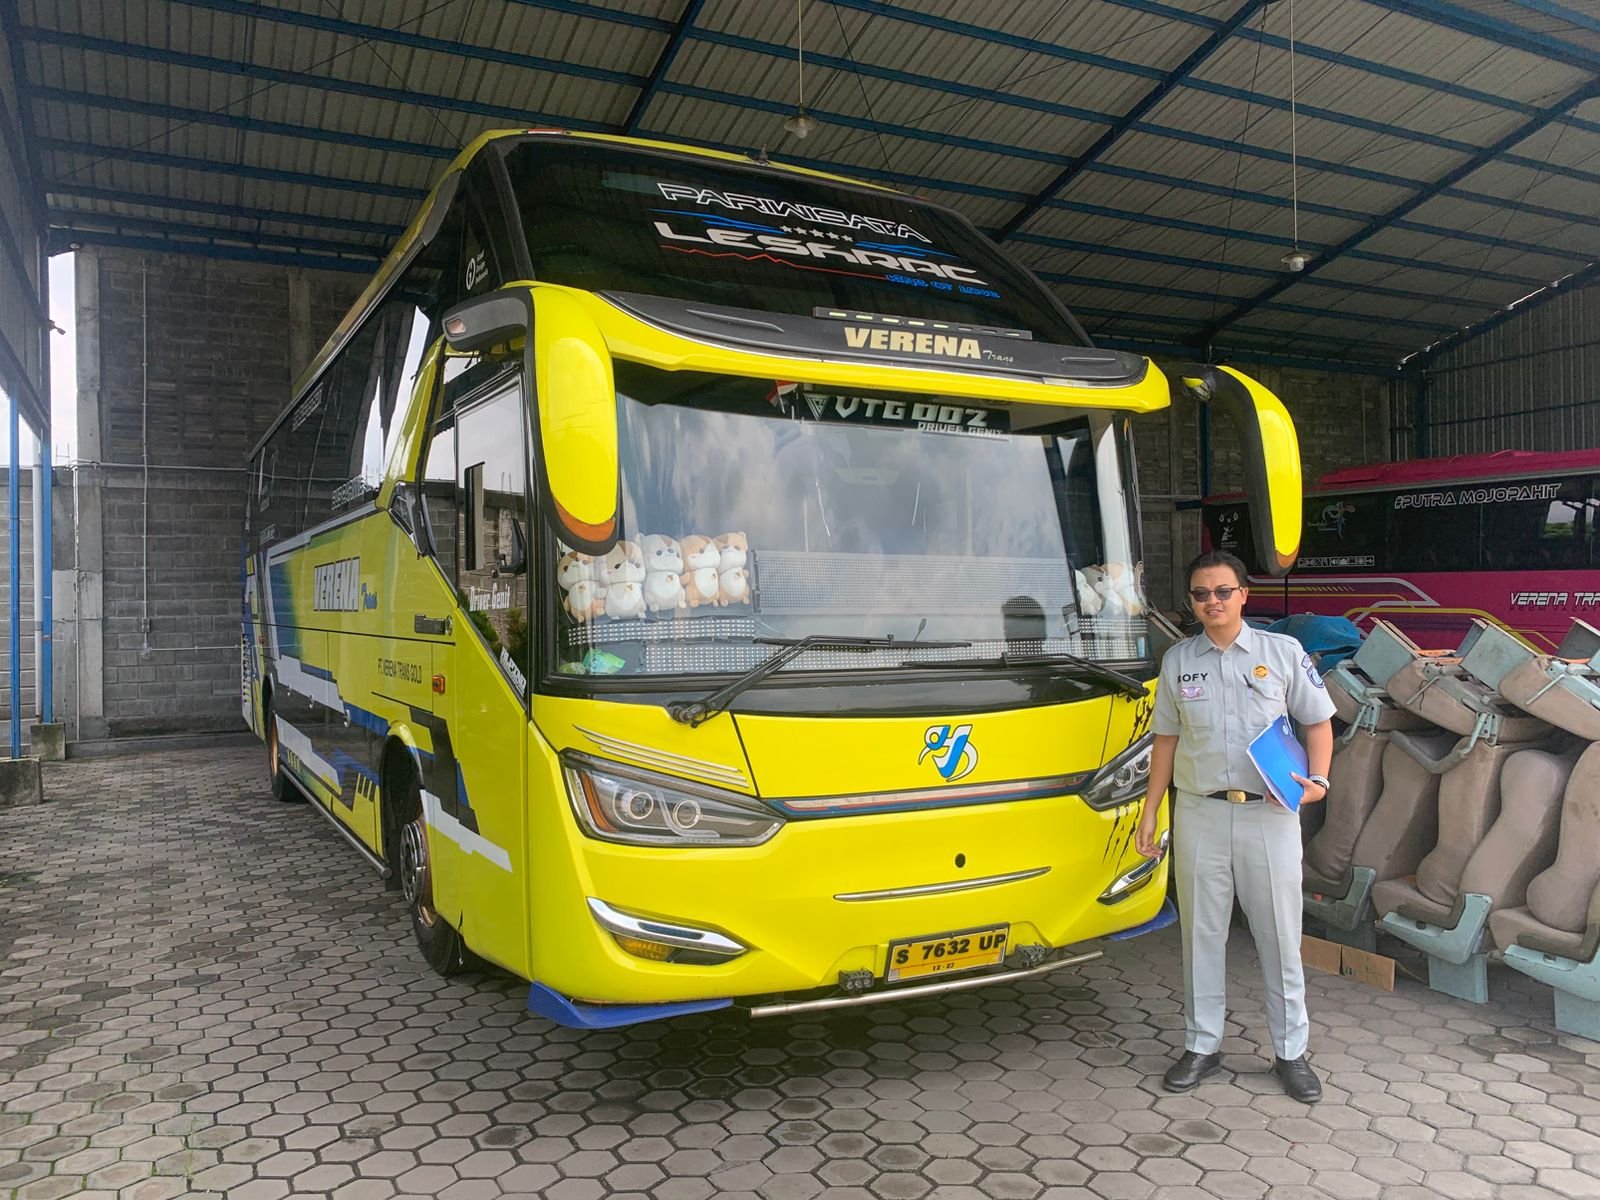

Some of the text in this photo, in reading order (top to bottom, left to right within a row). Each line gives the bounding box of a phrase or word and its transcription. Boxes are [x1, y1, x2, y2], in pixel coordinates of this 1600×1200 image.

[656, 182, 933, 244] PARIWISATA
[844, 326, 1014, 365] VERENA Trans
[835, 395, 989, 427] VTG 002
[1395, 483, 1562, 509] #PUTRA MOJOPAHIT
[313, 556, 360, 612] VERENA
[1510, 592, 1569, 606] VERENA
[896, 934, 1006, 964] S 7632 UP
